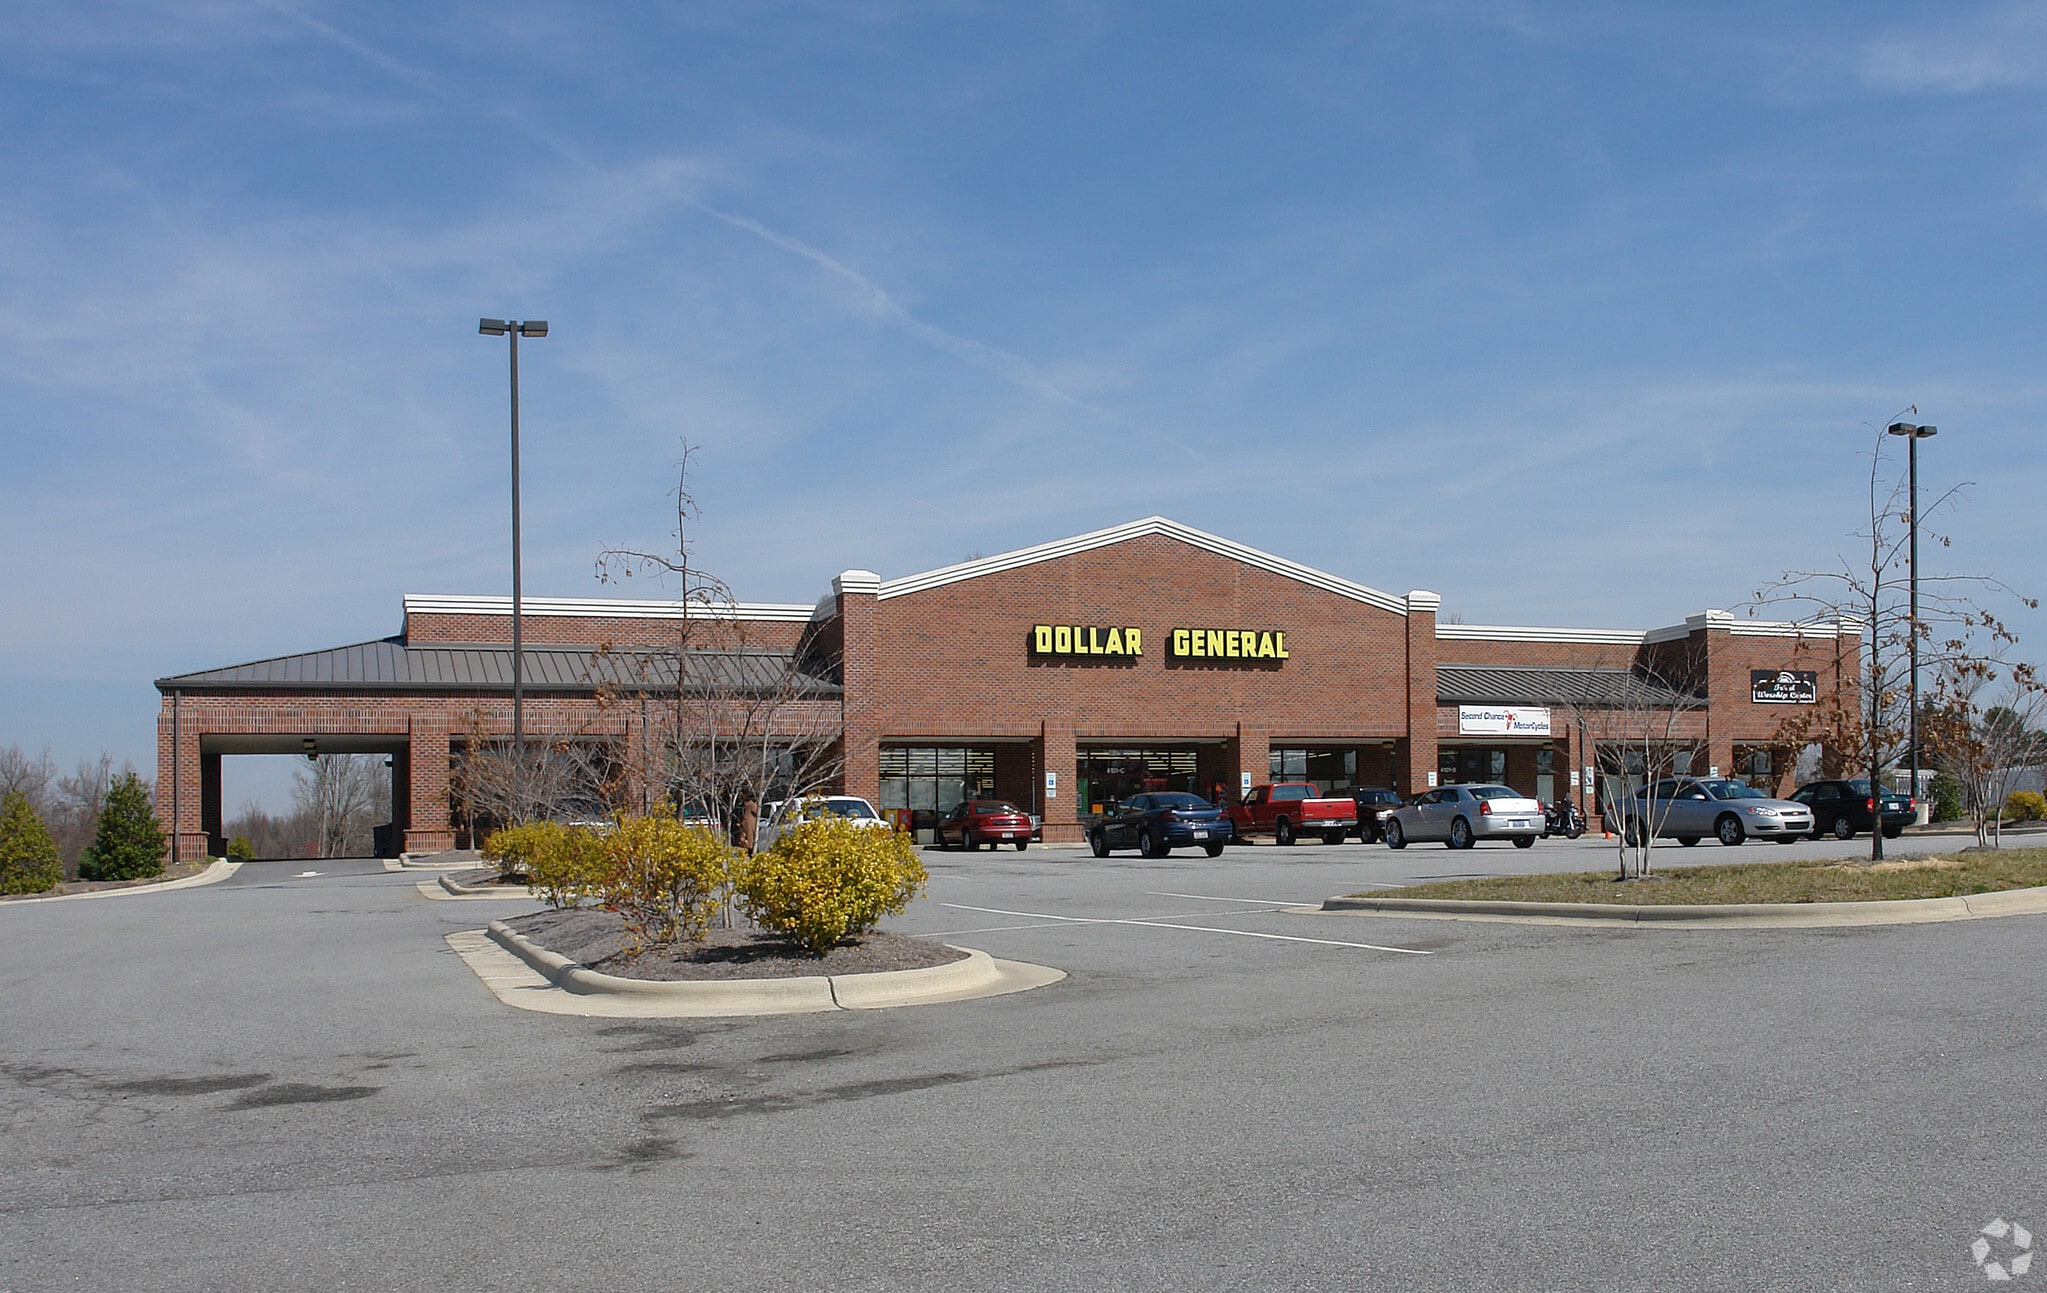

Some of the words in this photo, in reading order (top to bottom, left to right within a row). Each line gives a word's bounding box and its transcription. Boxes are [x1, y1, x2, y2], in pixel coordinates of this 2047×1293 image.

[1034, 625, 1143, 655] DOLLAR
[1173, 629, 1289, 658] GENERAL
[1757, 691, 1788, 700] Worship
[1461, 711, 1483, 720] Second
[1484, 712, 1505, 721] Chance
